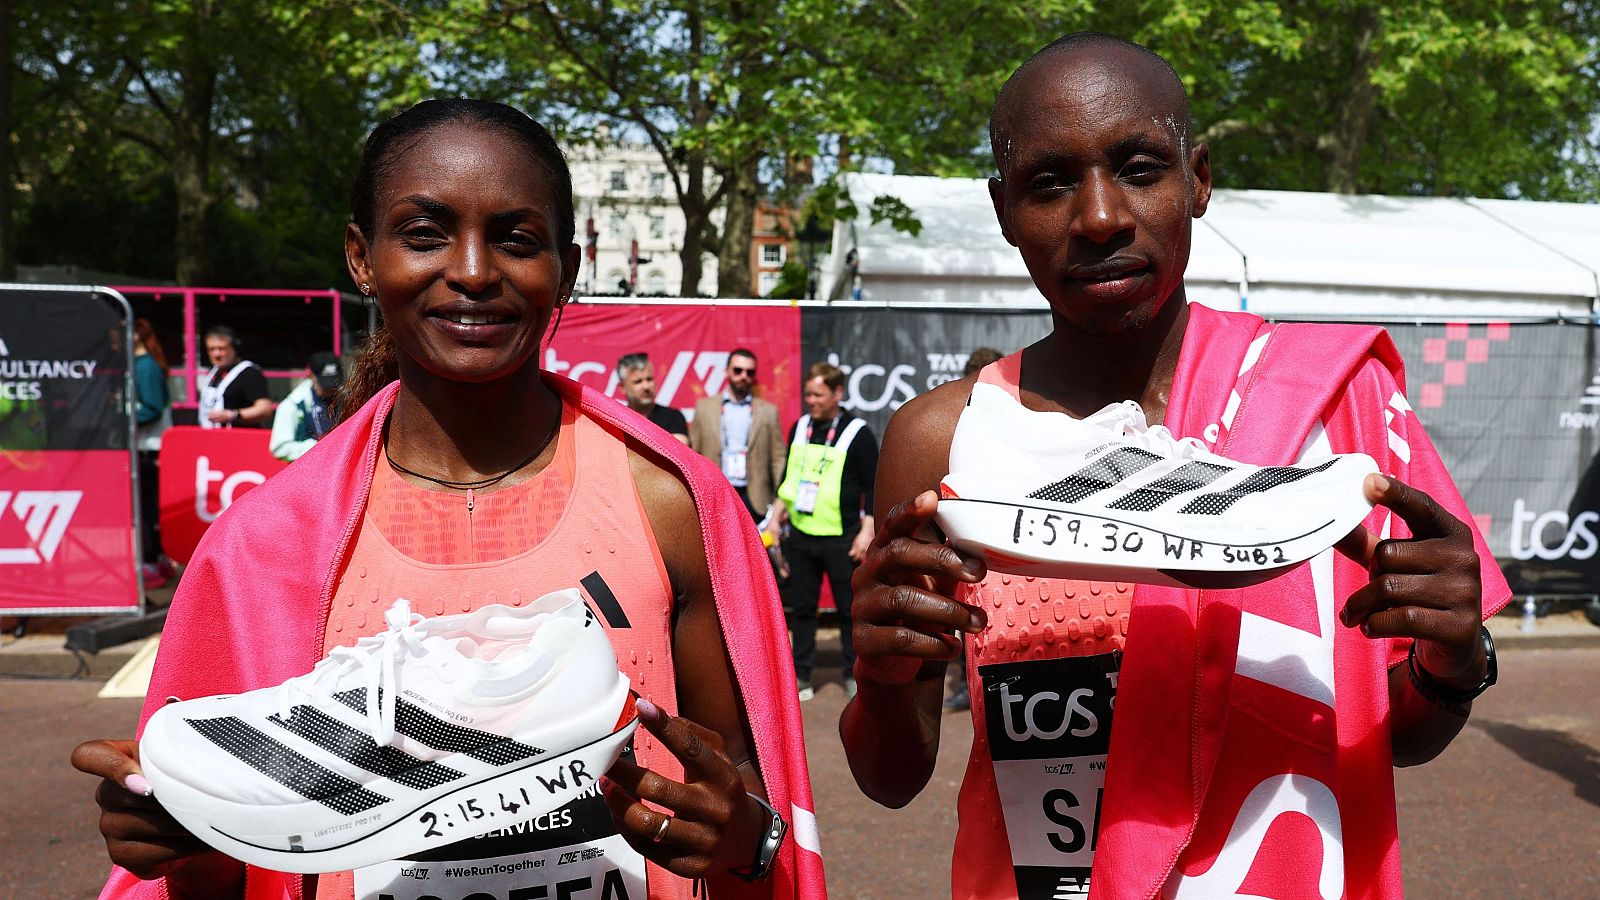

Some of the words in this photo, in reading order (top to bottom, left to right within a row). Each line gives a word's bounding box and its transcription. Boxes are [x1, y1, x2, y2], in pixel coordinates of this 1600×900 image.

[926, 353, 970, 372] TAT
[1013, 509, 1143, 552] 1:59.30
[1163, 534, 1204, 560] WR
[1510, 498, 1600, 560] tcs
[1000, 683, 1098, 741] tcs
[419, 788, 530, 837] 2:15.41
[536, 760, 593, 793] WR
[445, 858, 546, 878] #WeRunTogether
